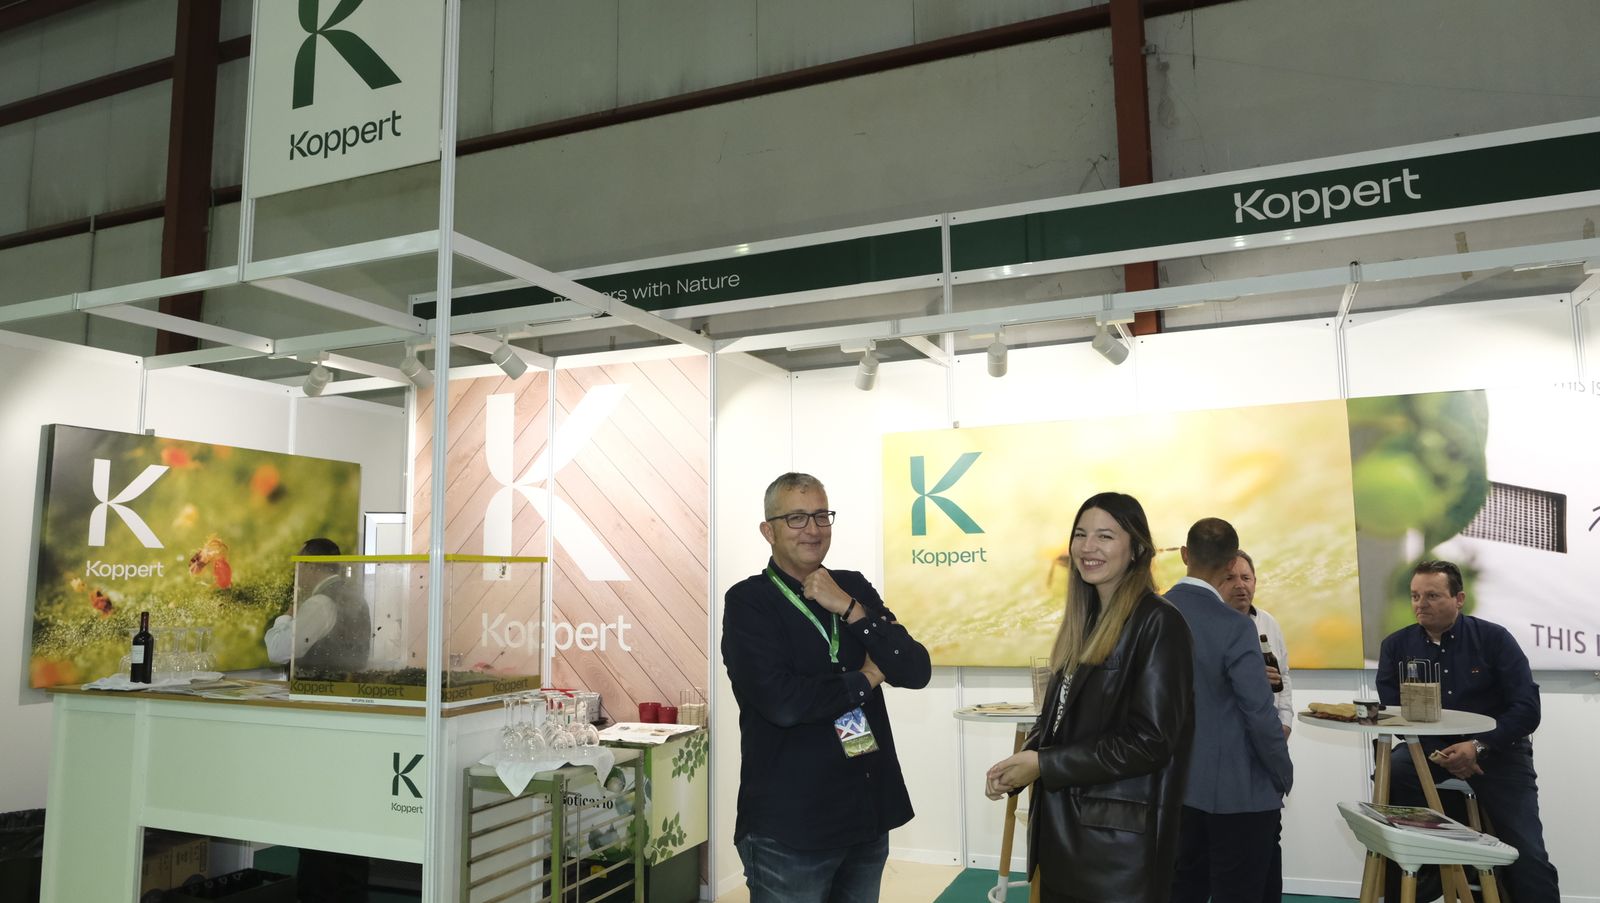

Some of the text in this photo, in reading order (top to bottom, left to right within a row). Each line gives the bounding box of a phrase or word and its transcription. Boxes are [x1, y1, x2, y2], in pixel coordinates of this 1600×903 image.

[289, 110, 402, 160] Koppert
[1233, 168, 1422, 224] Koppert
[632, 281, 671, 299] with
[676, 274, 741, 294] Nature
[87, 458, 170, 549] K
[910, 451, 985, 536] K
[85, 560, 165, 581] Koppert
[912, 547, 988, 567] Koppert
[480, 612, 633, 658] Koppert
[1530, 623, 1587, 654] THIS
[289, 681, 335, 694] Koppert
[357, 683, 405, 697] Koppert
[391, 752, 425, 799] K
[391, 802, 424, 815] Koppert
